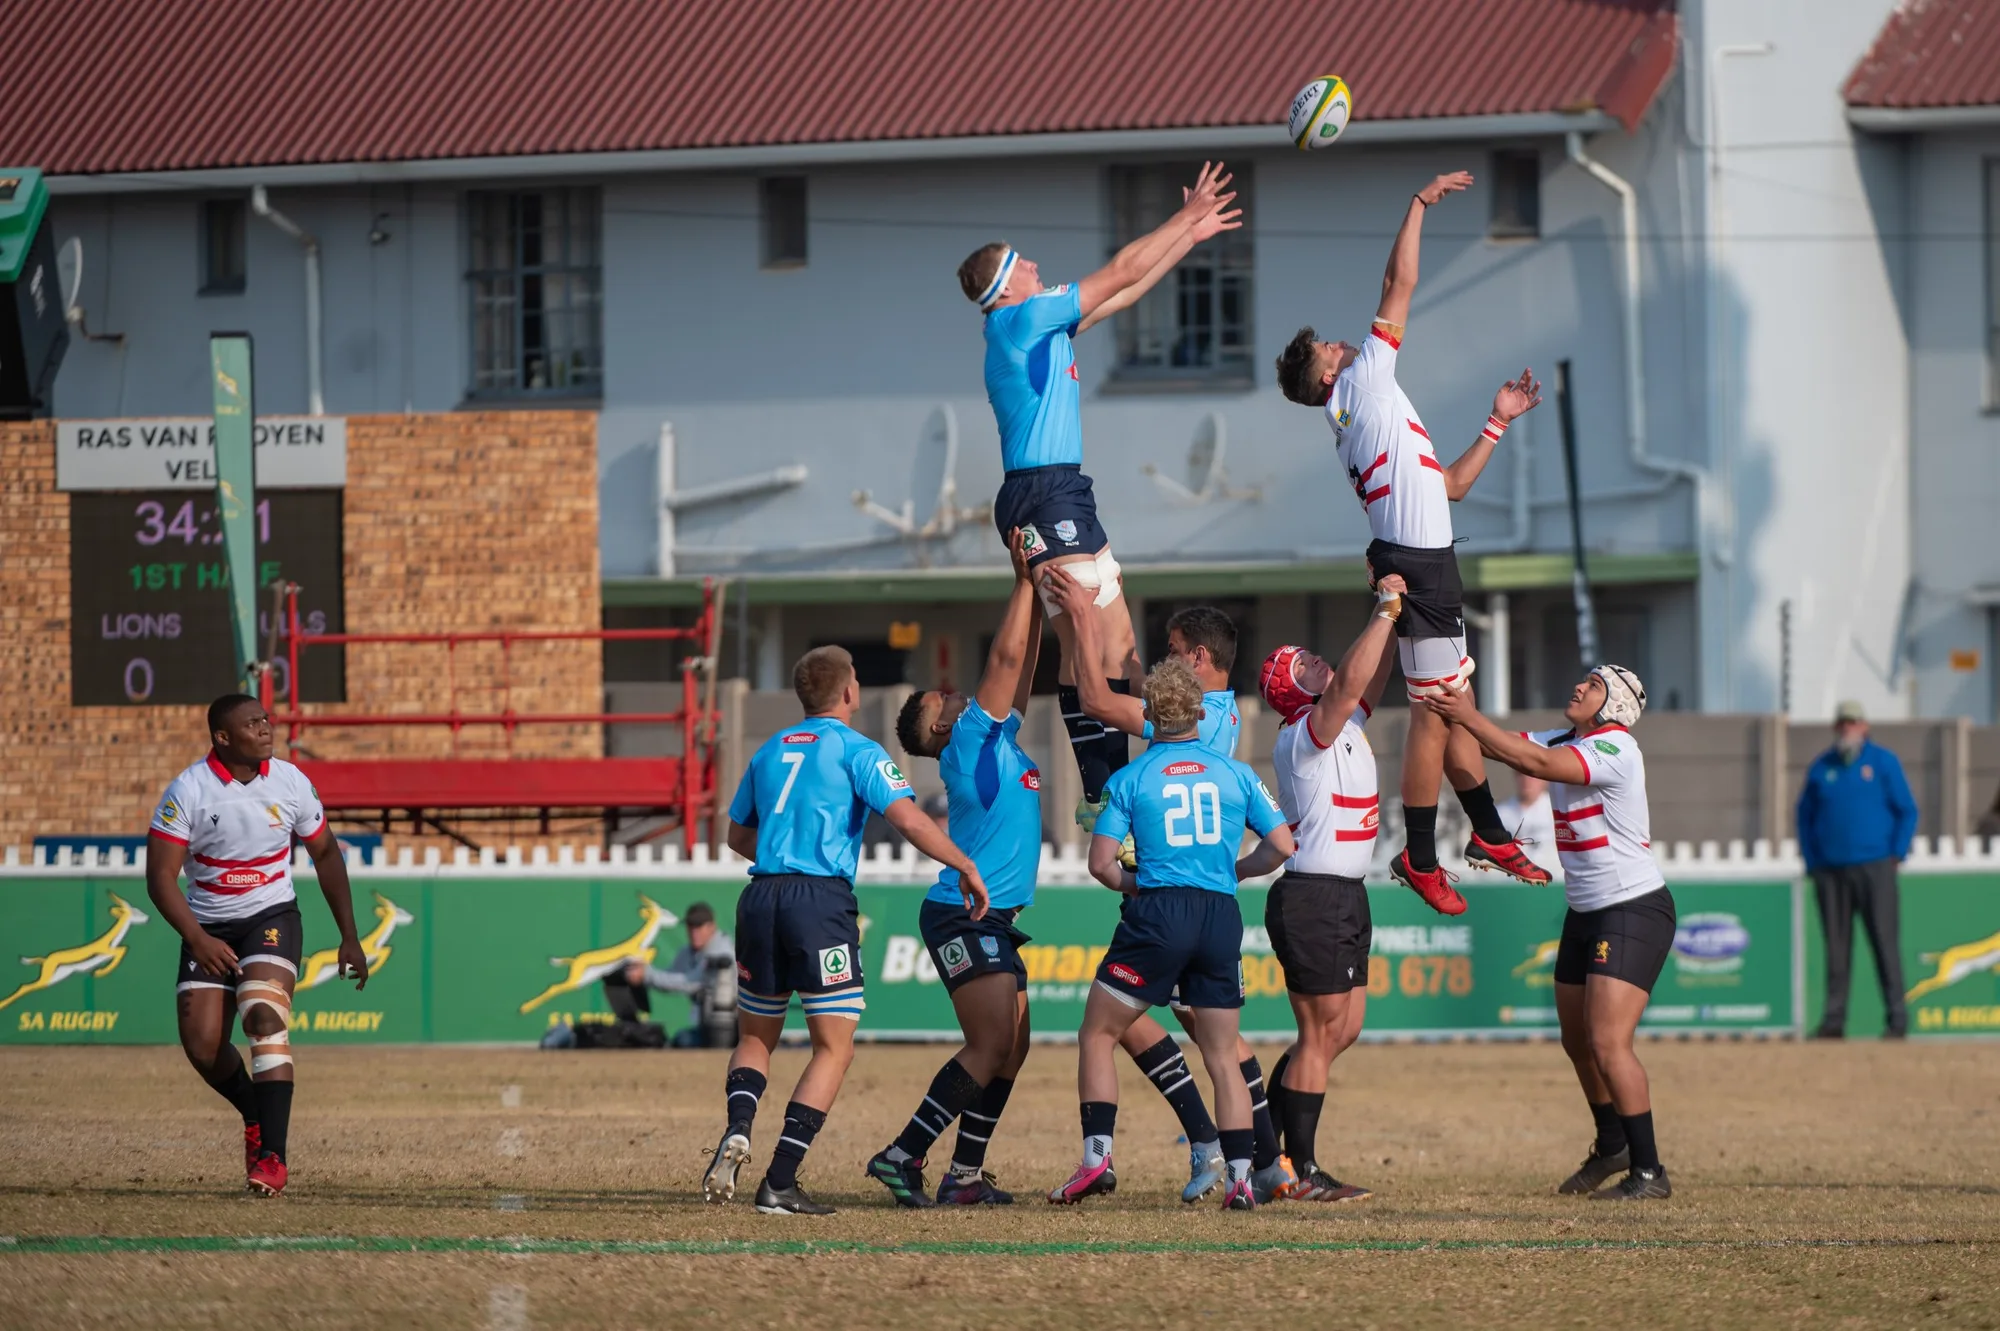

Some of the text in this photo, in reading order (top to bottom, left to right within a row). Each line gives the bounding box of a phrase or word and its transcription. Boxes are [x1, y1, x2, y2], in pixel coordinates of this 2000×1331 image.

[77, 425, 325, 448] RAS VAN OYEN
[166, 460, 217, 481] VEL
[135, 499, 271, 545] 34:1
[130, 563, 187, 590] 1ST
[102, 612, 182, 639] LIONS
[124, 657, 154, 700] 0
[788, 735, 814, 743] OBARO
[1169, 764, 1200, 775] OBARO
[774, 752, 805, 814] 7
[1162, 782, 1222, 847] 20
[226, 872, 261, 887] OBARO
[825, 972, 850, 984] SPAR
[1112, 966, 1139, 985] OBARO
[1399, 956, 1473, 997] 678
[19, 1011, 118, 1031] SA RUGBY
[313, 1011, 384, 1031] RUGBY
